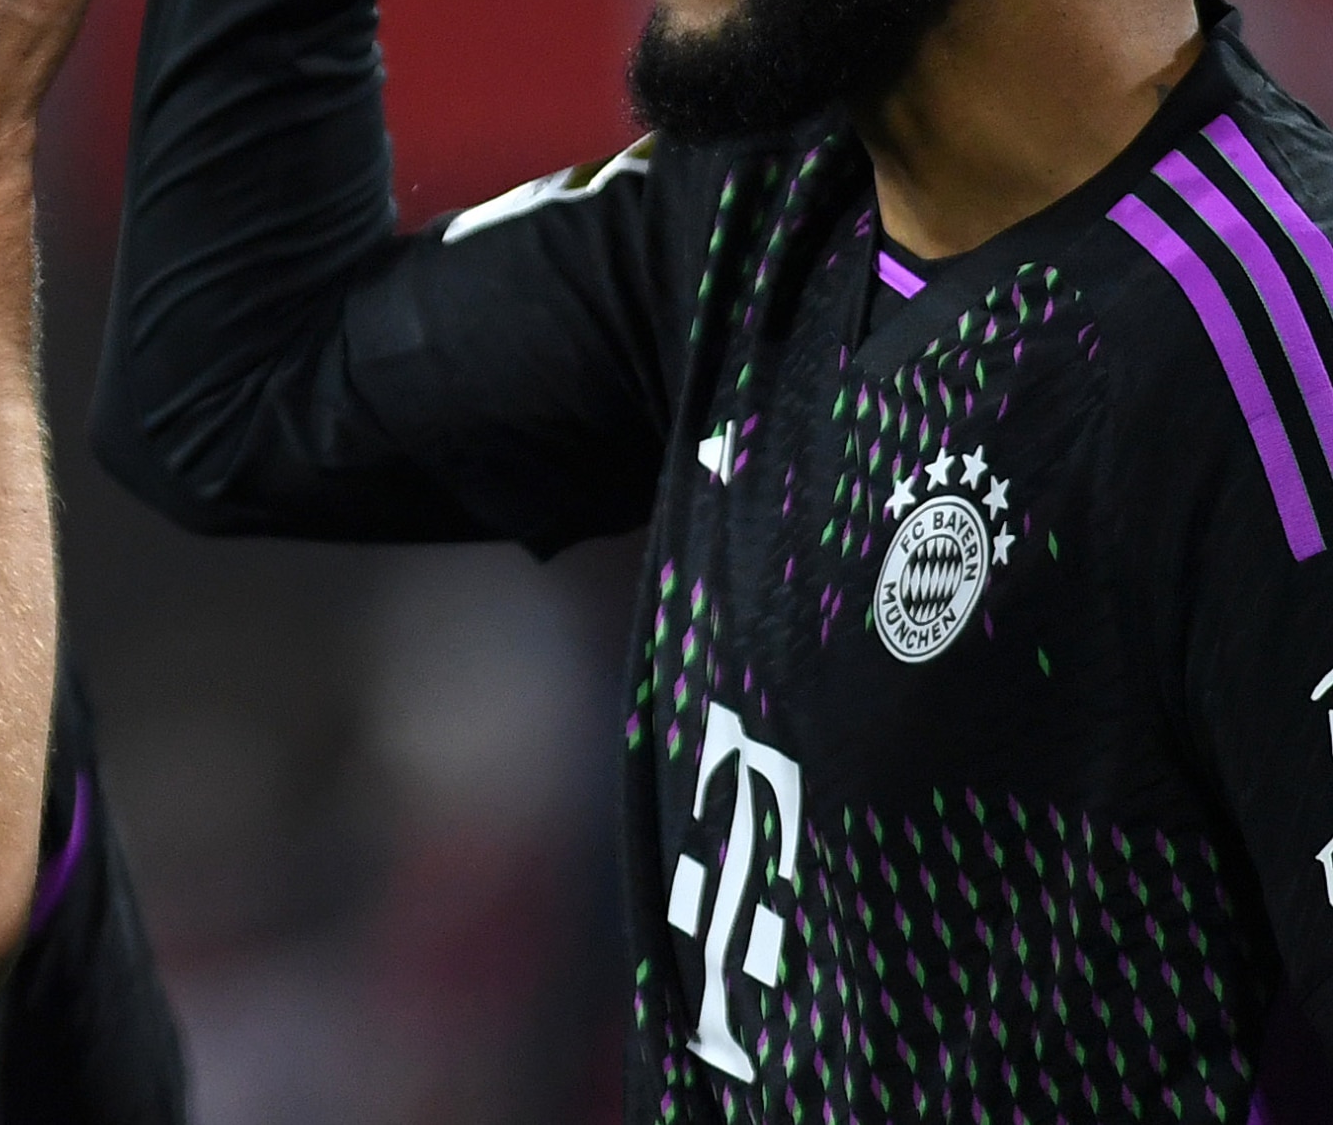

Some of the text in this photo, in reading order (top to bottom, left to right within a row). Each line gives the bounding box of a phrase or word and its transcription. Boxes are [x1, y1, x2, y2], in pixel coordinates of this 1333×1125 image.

[899, 511, 979, 583] FC BAYERN
[881, 580, 958, 650] MÜNCHEN
